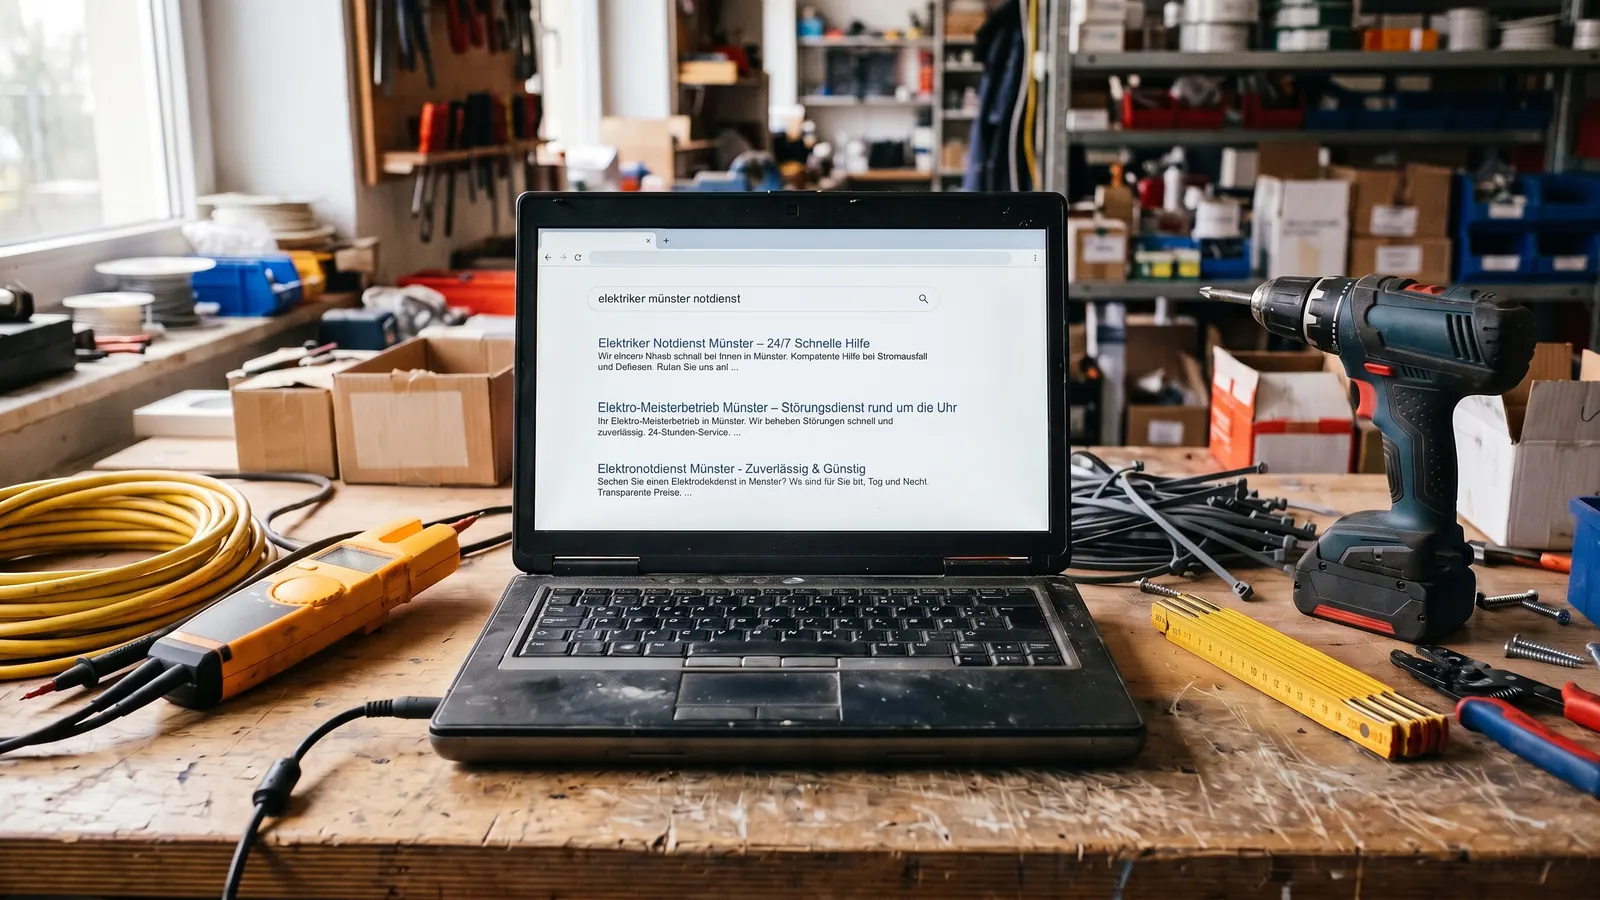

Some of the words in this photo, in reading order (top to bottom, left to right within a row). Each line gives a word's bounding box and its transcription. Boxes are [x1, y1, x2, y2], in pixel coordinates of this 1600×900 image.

[598, 293, 647, 303] elektriker
[648, 293, 692, 303] münster
[693, 293, 741, 303] notdienst
[598, 337, 651, 348] Elektriker
[653, 337, 706, 348] Notdienst
[708, 337, 755, 348] Münster
[766, 337, 792, 348] 24/7
[794, 337, 843, 348] Schnelle
[845, 337, 871, 348] Hilfe
[597, 351, 613, 359] Wir
[753, 352, 789, 360] Münster.
[841, 351, 861, 360] Hilfe
[862, 352, 876, 360] bei
[876, 351, 928, 360] Stromausfall
[597, 362, 614, 370] und
[683, 362, 697, 371] Sie
[597, 401, 720, 413] Elektro-Meisterbetrieb
[722, 401, 769, 413] Münster
[781, 401, 865, 415] Störungsdienst
[867, 401, 893, 413] rund
[896, 403, 914, 413] um
[916, 401, 934, 413] die
[937, 401, 958, 413] Uhr
[597, 416, 610, 424] Ihr
[610, 416, 700, 425] Elektro-Meisterbetrieb
[701, 416, 710, 424] in
[711, 416, 747, 425] Münster.
[748, 416, 764, 424] Wir
[764, 416, 801, 425] beheben
[802, 416, 846, 427] Störungen
[846, 416, 876, 425] schnell
[877, 416, 894, 425] und
[597, 427, 646, 438] zuverlässig.
[647, 427, 731, 436] 24-Stunden-Service.
[597, 463, 687, 474] Elektronotdienst
[689, 463, 736, 474] Münster
[744, 463, 809, 476] Zuverlässig
[811, 462, 821, 474] &
[823, 462, 866, 476] Günstig
[630, 476, 645, 485] Sie
[646, 477, 670, 485] einen
[738, 477, 747, 485] in
[804, 477, 822, 485] sind
[823, 477, 836, 485] für
[837, 477, 851, 485] Sie
[884, 477, 901, 485] und
[597, 487, 652, 498] Transparente
[653, 487, 682, 496] Preise.
